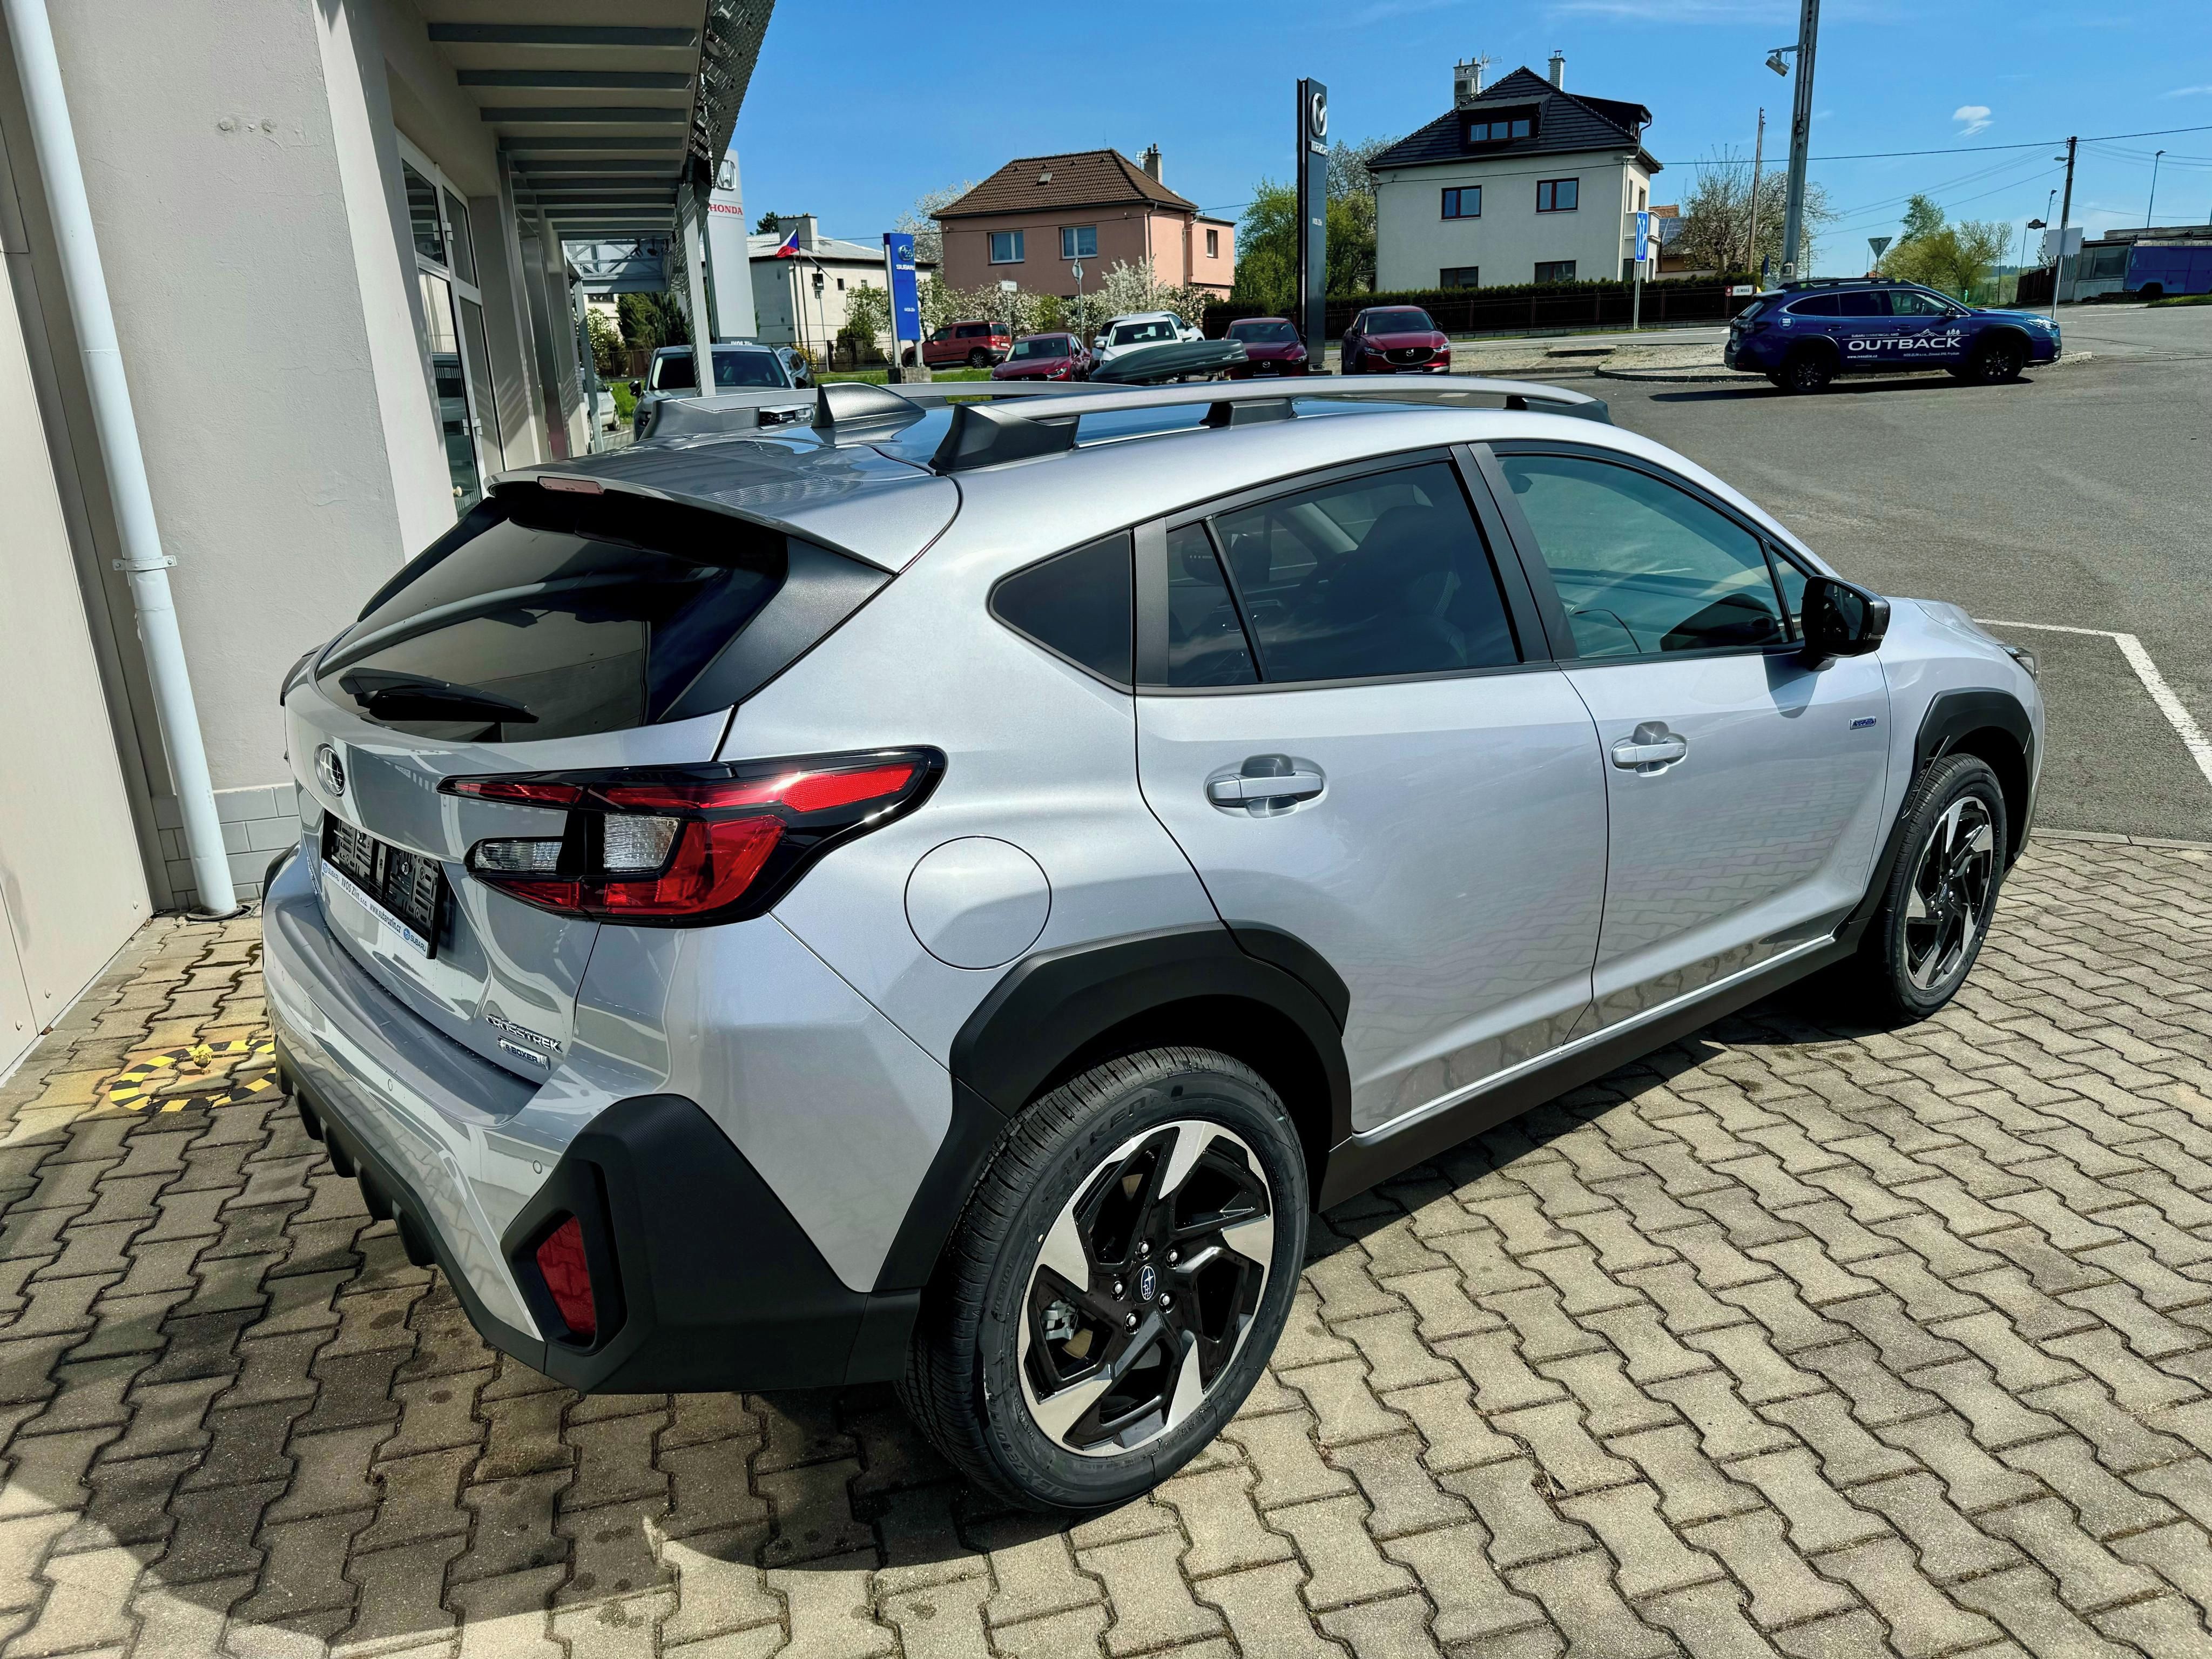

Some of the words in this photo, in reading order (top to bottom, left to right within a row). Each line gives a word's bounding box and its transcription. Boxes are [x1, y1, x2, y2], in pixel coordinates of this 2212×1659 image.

[709, 204, 744, 215] HONDA
[1848, 337, 1962, 351] OUTBACK
[341, 878, 352, 892] IVOS
[370, 903, 401, 933] www.subaruzlin.cz
[410, 935, 427, 952] SUBARU
[486, 1014, 563, 1054] CROSSTREK
[505, 1044, 538, 1063] e-BOXER
